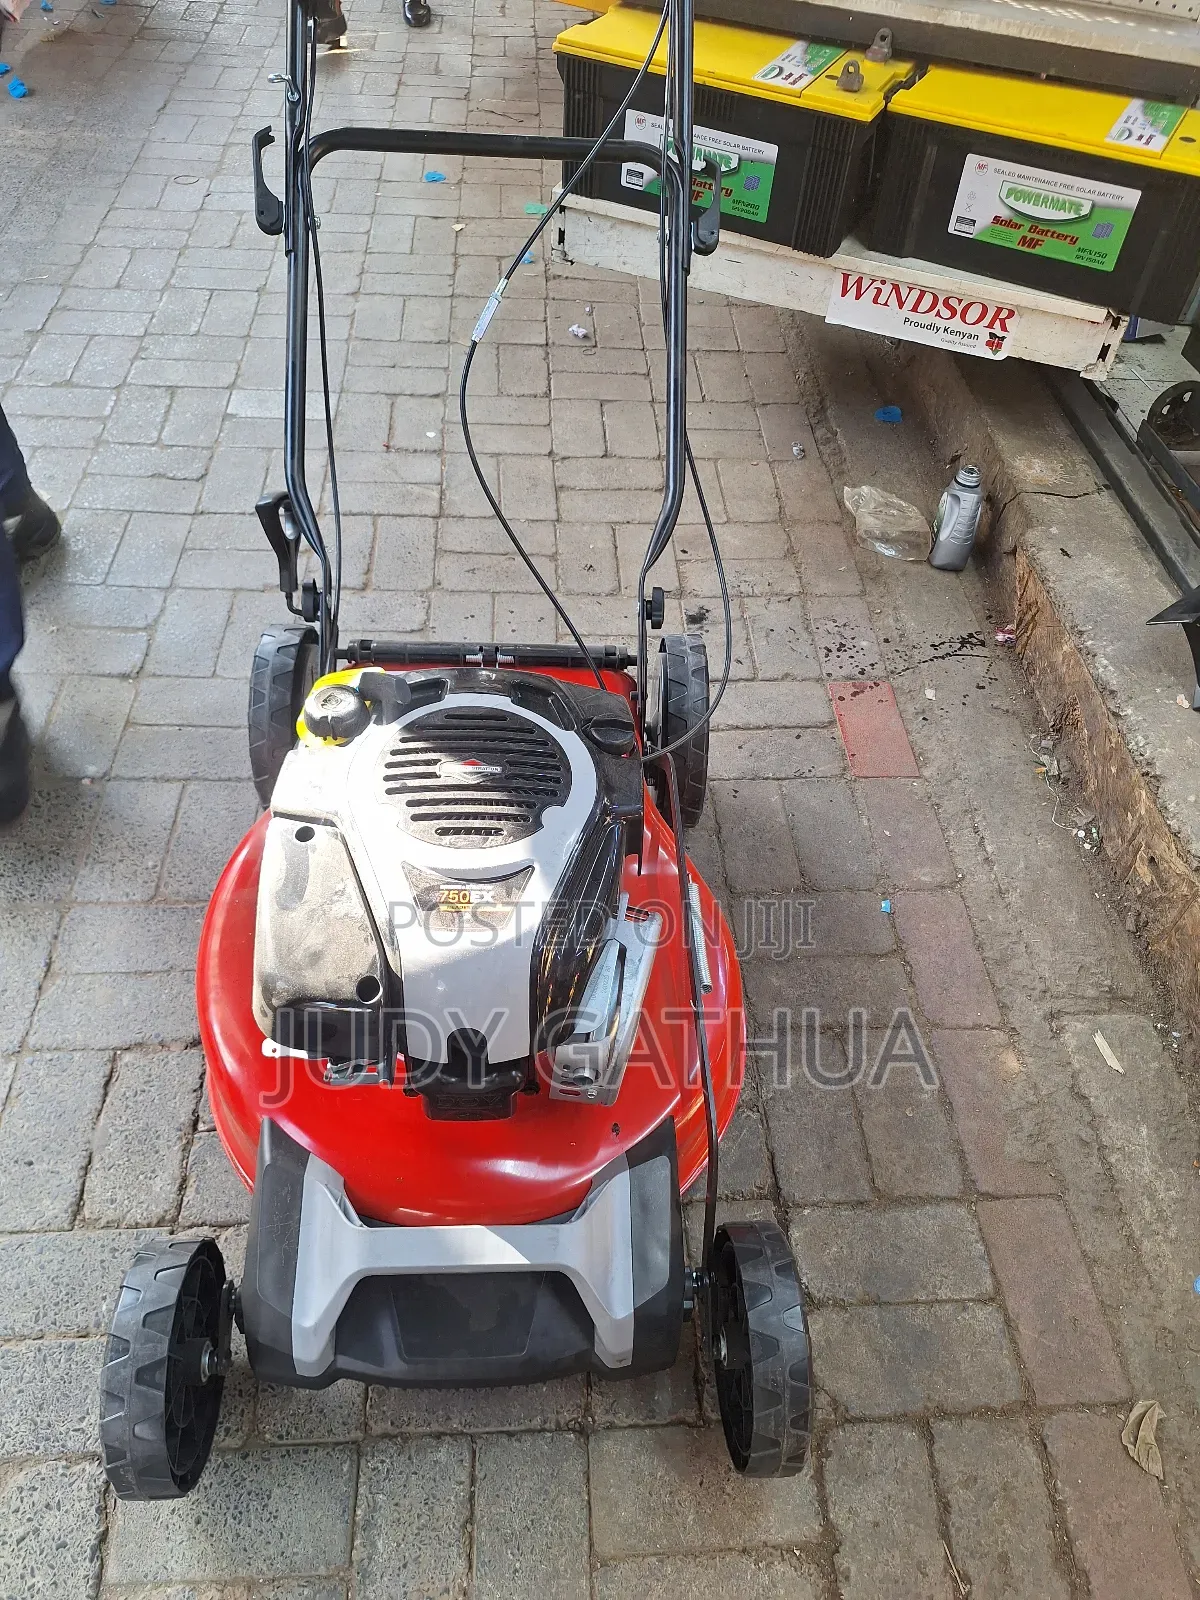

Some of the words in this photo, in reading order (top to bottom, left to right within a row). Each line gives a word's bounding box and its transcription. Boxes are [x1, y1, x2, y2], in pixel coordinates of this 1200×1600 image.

[722, 140, 742, 149] SOLAR
[976, 162, 988, 171] MF
[993, 167, 1016, 178] SEALED
[1016, 173, 1058, 188] MAINTENANCE
[1059, 182, 1075, 191] FREE
[1075, 186, 1096, 196] SOLAR
[1096, 190, 1124, 201] BATTERY
[1005, 186, 1084, 215] POWERMATE
[991, 215, 1024, 231] Solar
[1027, 223, 1079, 246] Battery
[1016, 235, 1045, 251] MF
[903, 316, 941, 335] Proudly
[942, 323, 980, 341] Kenyan
